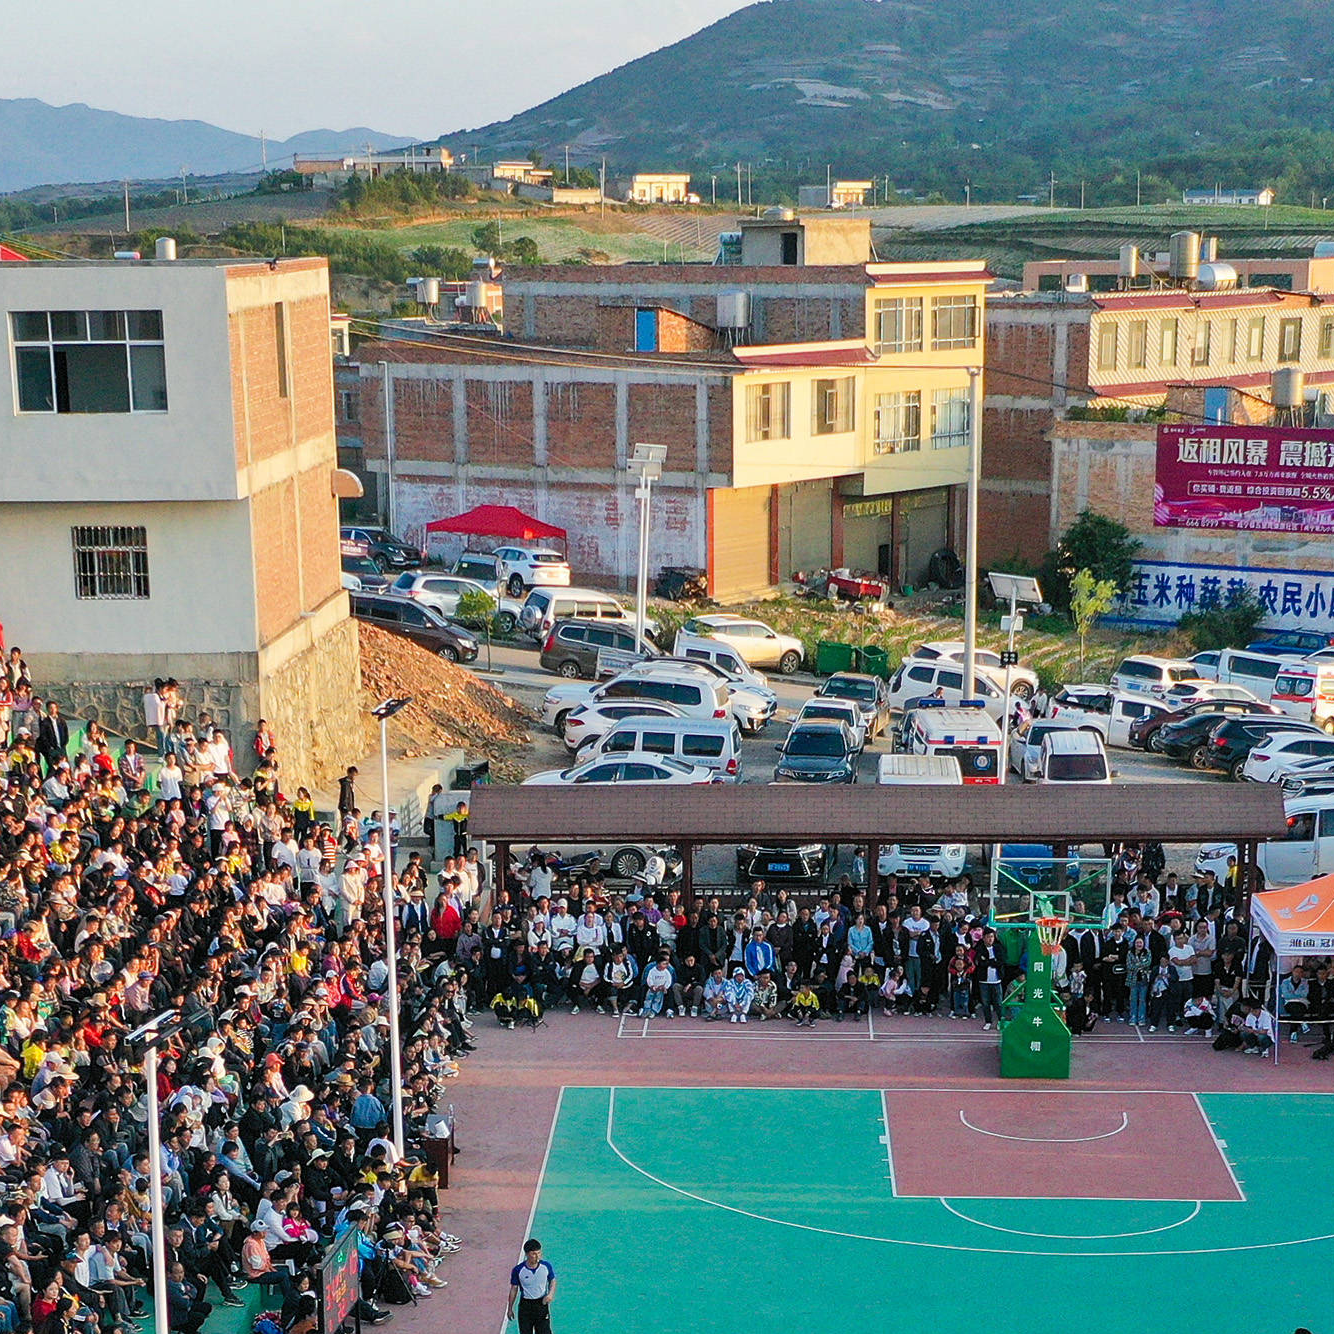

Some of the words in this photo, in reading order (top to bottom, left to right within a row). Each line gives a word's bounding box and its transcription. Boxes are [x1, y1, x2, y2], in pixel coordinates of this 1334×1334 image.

[1177, 437, 1268, 466] 返租风暴
[1030, 961, 1044, 1052] 阳光牛棚
